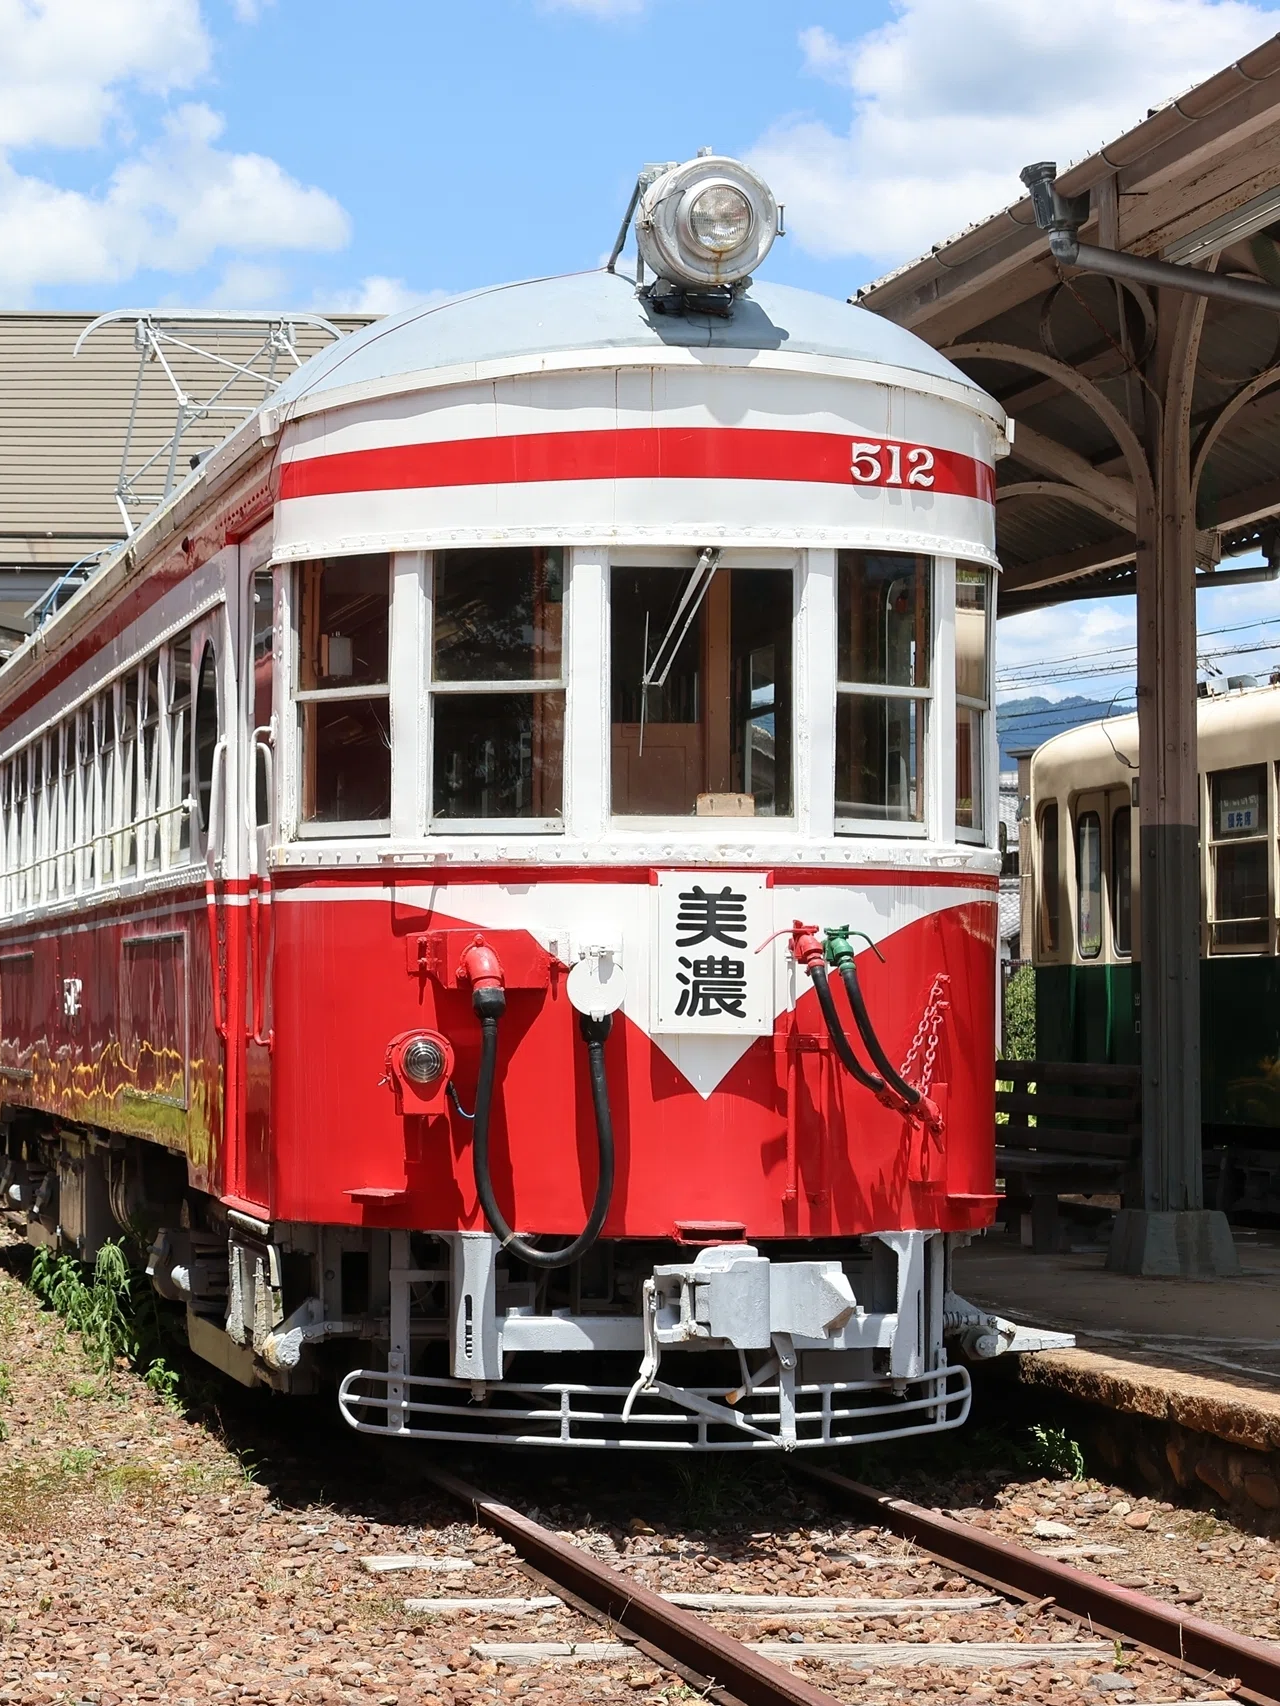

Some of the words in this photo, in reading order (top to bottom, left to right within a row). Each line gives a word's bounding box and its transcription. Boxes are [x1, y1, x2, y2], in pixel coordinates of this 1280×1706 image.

[850, 442, 935, 487] 512
[1228, 811, 1251, 829] 優先席
[675, 885, 748, 1018] 美濃
